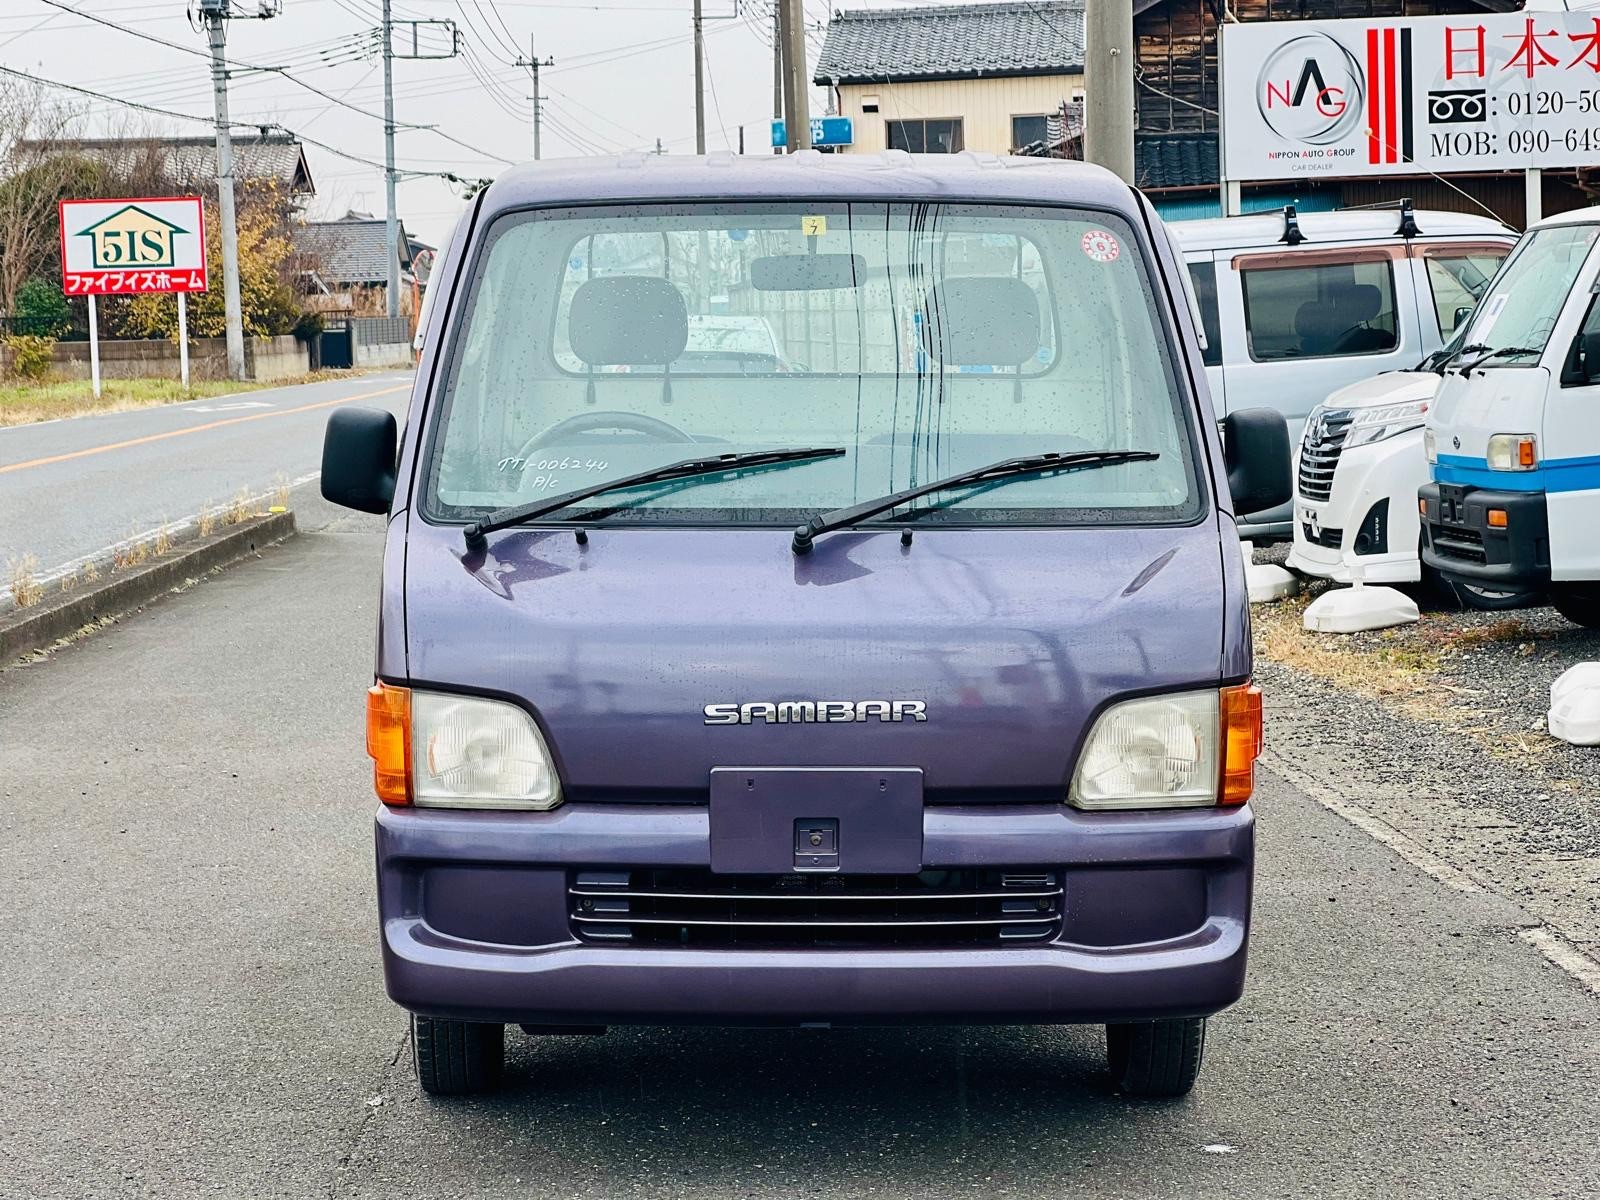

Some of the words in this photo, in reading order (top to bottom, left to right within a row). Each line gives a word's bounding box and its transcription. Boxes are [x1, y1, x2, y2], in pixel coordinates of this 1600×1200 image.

[1268, 151, 1300, 160] NIPPON
[1301, 150, 1324, 159] AUTO
[1326, 148, 1356, 157] GROUP
[1430, 130, 1498, 158] MOB:
[1291, 164, 1307, 172] CAR
[1307, 163, 1334, 171] DEALER
[66, 271, 204, 293] ファイブイズホーム
[704, 701, 927, 725] SAMBAR
